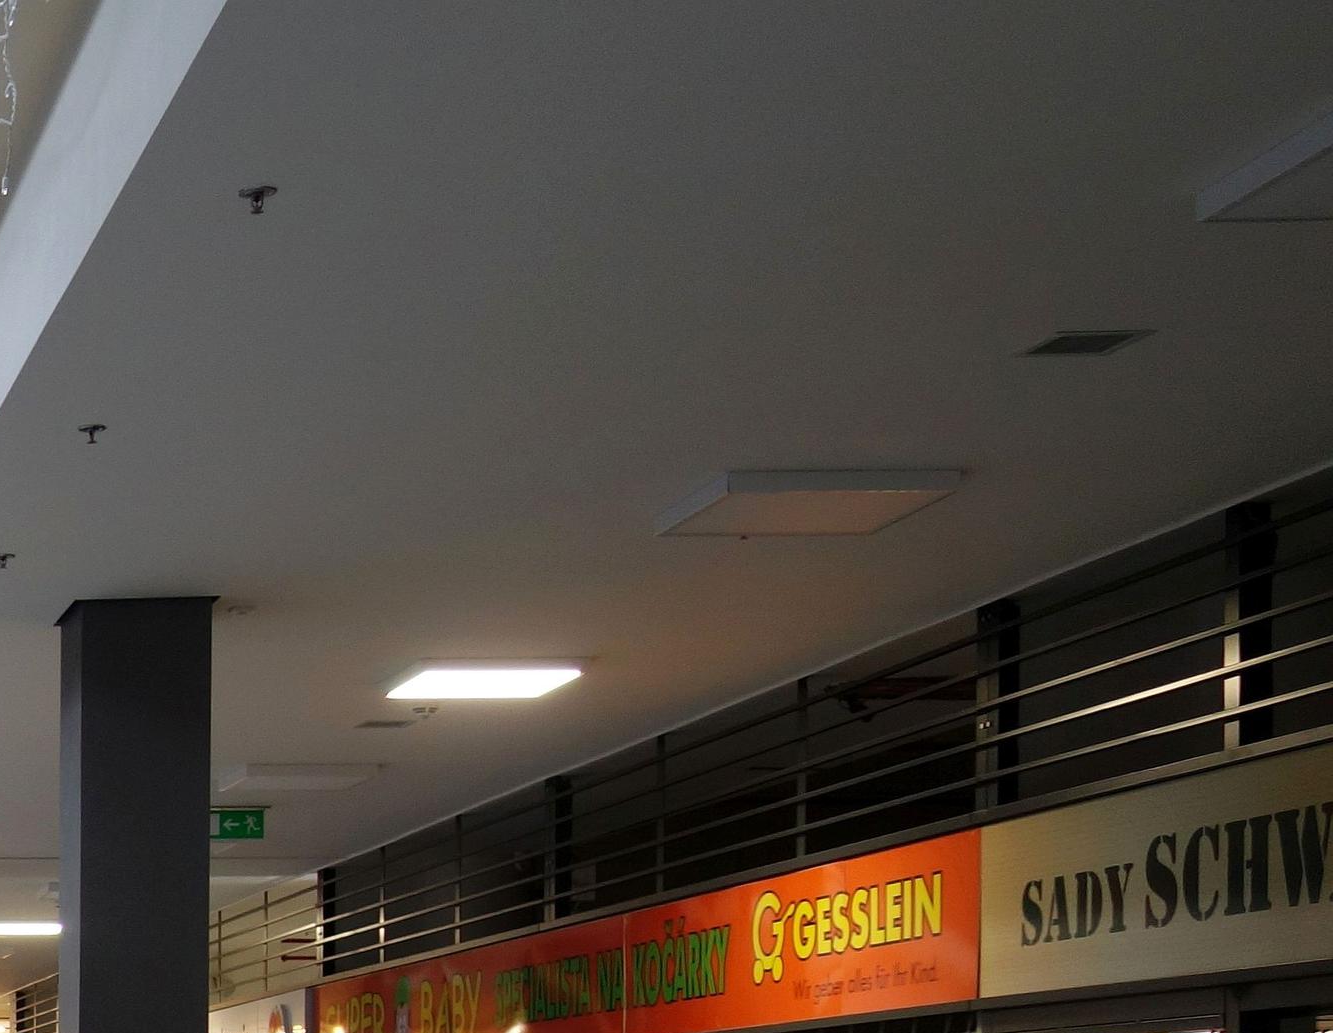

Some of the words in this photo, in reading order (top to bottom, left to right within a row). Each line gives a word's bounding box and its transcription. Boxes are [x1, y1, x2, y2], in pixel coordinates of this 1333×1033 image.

[792, 870, 943, 961] GESSLEIN
[1020, 862, 1134, 947] SADY
[1144, 801, 1333, 929] SCHW
[597, 947, 624, 1013] NA
[632, 915, 731, 1008] KOČÁRKY
